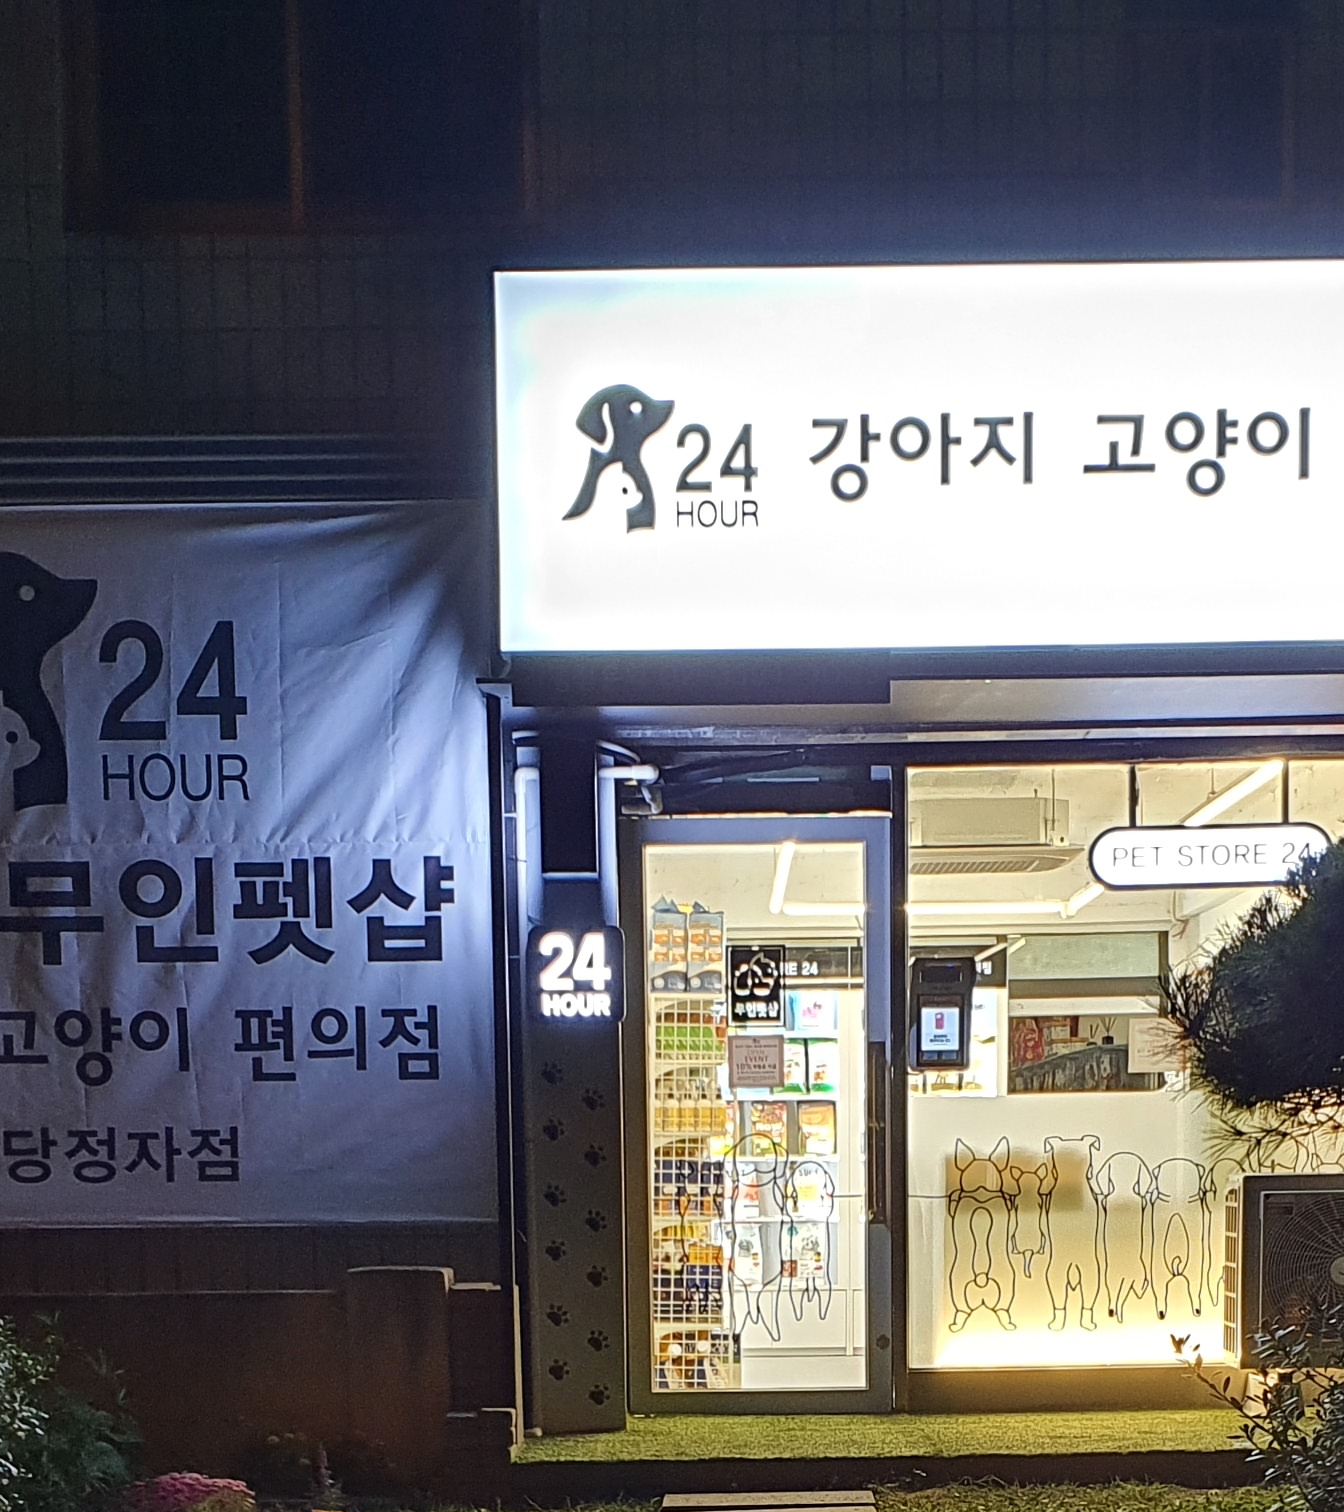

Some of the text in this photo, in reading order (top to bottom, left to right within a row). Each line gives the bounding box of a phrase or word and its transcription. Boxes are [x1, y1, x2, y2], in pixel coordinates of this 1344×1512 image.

[675, 423, 759, 493] 24
[808, 410, 1035, 501] 강아지
[1082, 406, 1312, 497] 고양이
[675, 499, 760, 528] HOUR
[98, 619, 248, 742] 24
[101, 752, 251, 802] HOUR
[1112, 845, 1163, 867] PET
[1177, 843, 1268, 867] STORE
[539, 932, 612, 991] 24
[801, 960, 819, 976] 24
[540, 994, 611, 1017] HOUR
[232, 1004, 441, 1082] 편의점
[744, 1055, 769, 1063] EVENT
